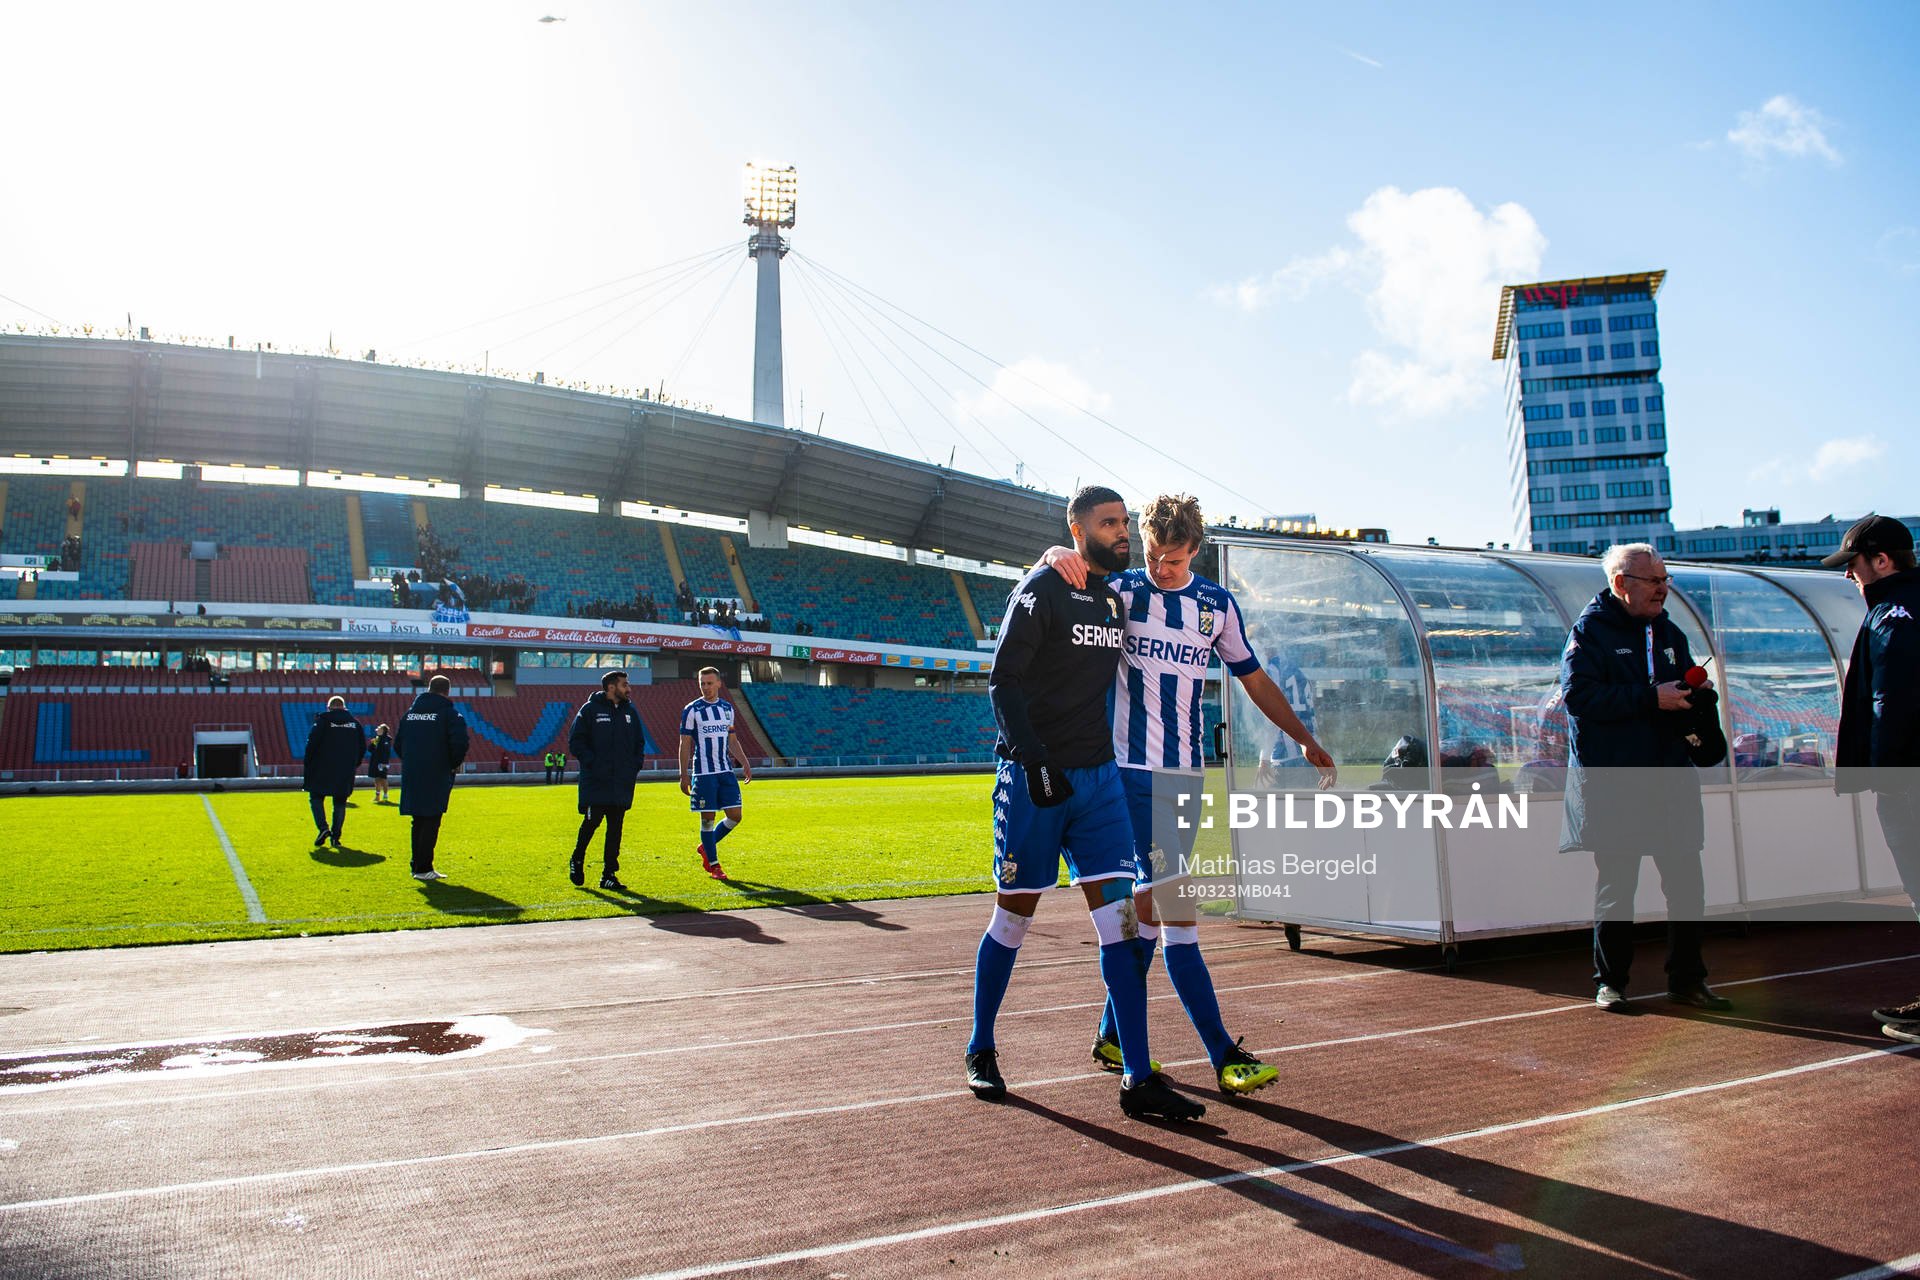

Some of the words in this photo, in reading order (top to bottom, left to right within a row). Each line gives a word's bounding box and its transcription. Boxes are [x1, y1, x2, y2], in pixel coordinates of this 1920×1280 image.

[348, 623, 379, 633] RASTA
[391, 624, 420, 634] RASTA
[431, 625, 461, 637] RASTA
[1071, 623, 1124, 649] SERNEK
[472, 627, 504, 637] Estrella
[508, 628, 540, 639] Estrella
[545, 629, 582, 641] Estrella
[584, 631, 621, 644] Estrella
[627, 635, 657, 645] Estrella
[662, 637, 692, 648] Estrella
[703, 641, 732, 651] Estrella
[736, 643, 766, 654] Estrella
[815, 650, 845, 660] Estrella
[848, 653, 877, 663] Estrella
[1126, 635, 1207, 667] SERNEKE
[406, 713, 438, 721] SERNEKE
[702, 724, 728, 734] SERNE
